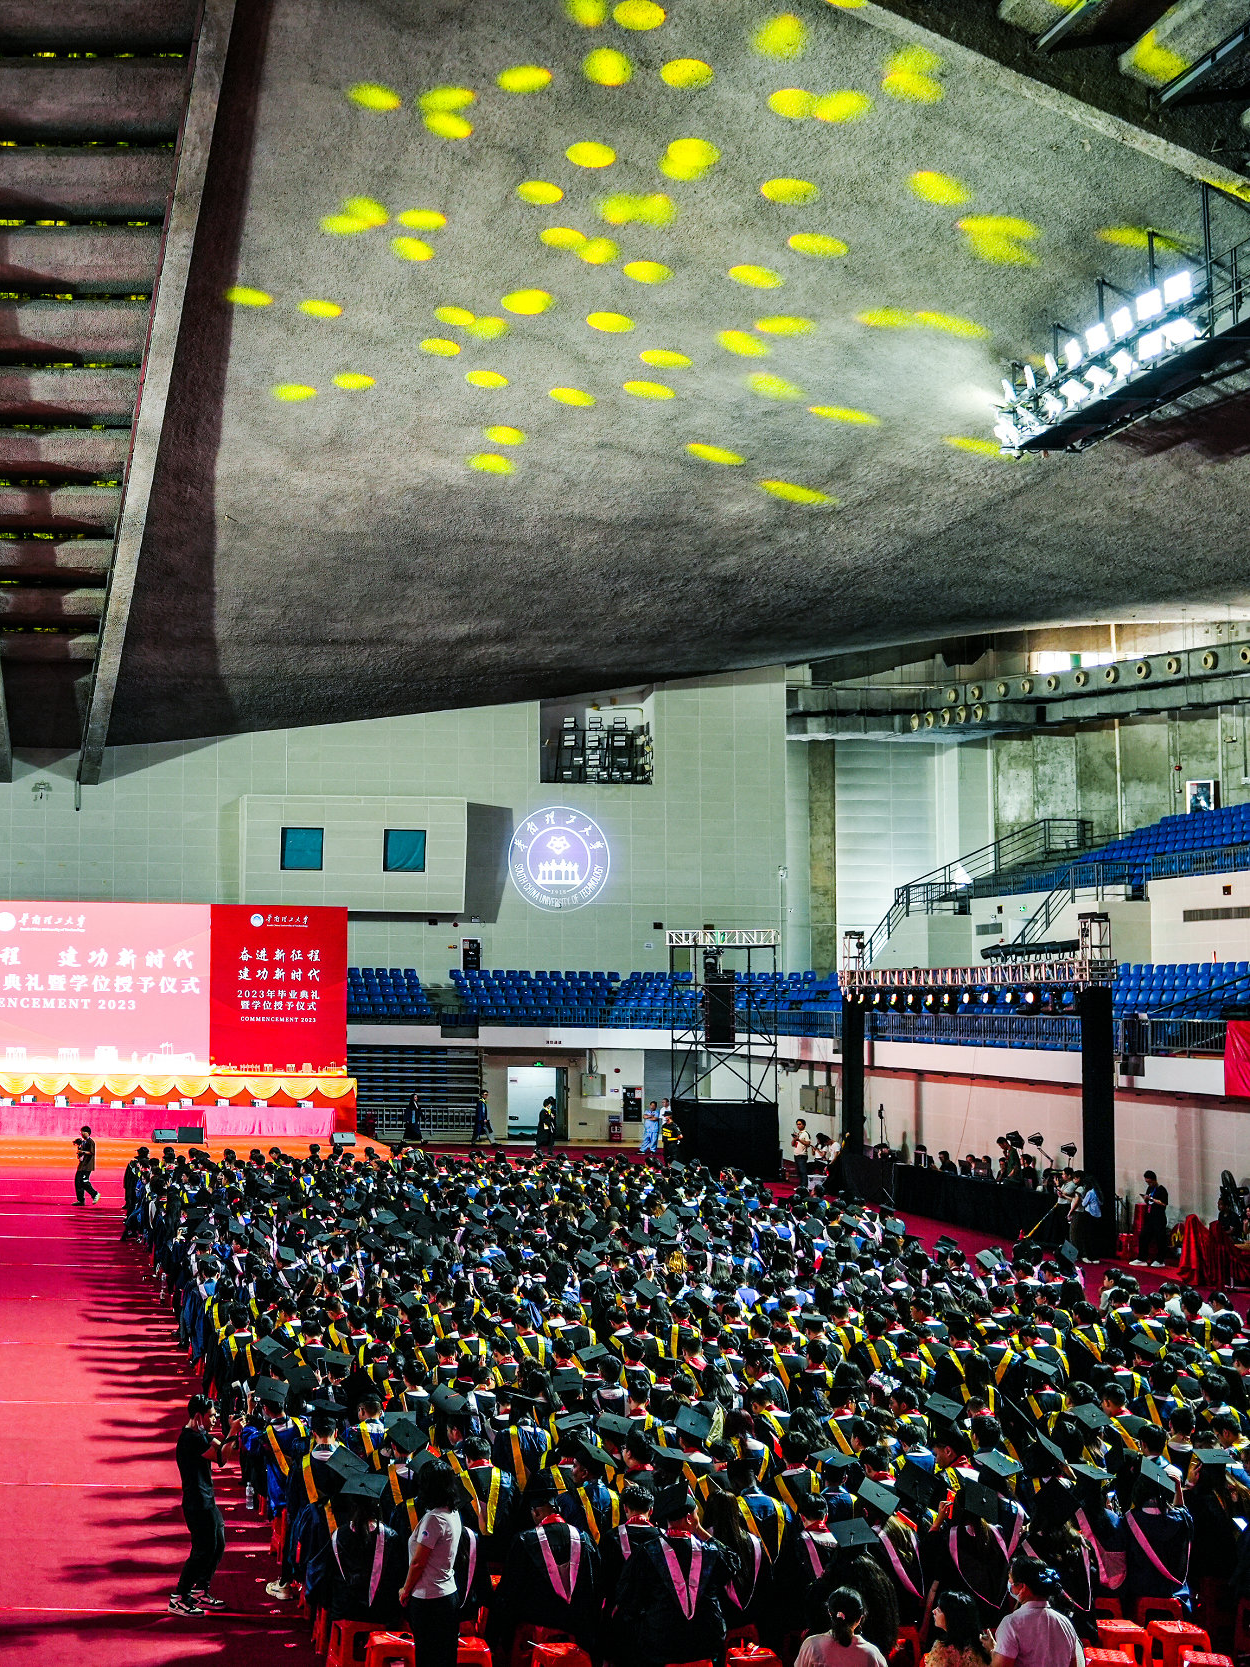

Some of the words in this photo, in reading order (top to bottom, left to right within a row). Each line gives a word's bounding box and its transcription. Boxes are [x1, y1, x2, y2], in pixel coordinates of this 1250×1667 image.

[515, 863, 527, 885] SOUTH
[523, 879, 539, 900] CHINA
[572, 893, 579, 904] OF
[578, 864, 604, 900] TECHNOLOGY
[57, 945, 194, 970] 建功新时代
[239, 947, 320, 963] 奋进新征程
[238, 966, 320, 982] 建功新时代
[237, 989, 320, 1000] 2023年毕业典礼
[98, 999, 136, 1010] 2023
[240, 1000, 317, 1011] 暨学位授予仪式
